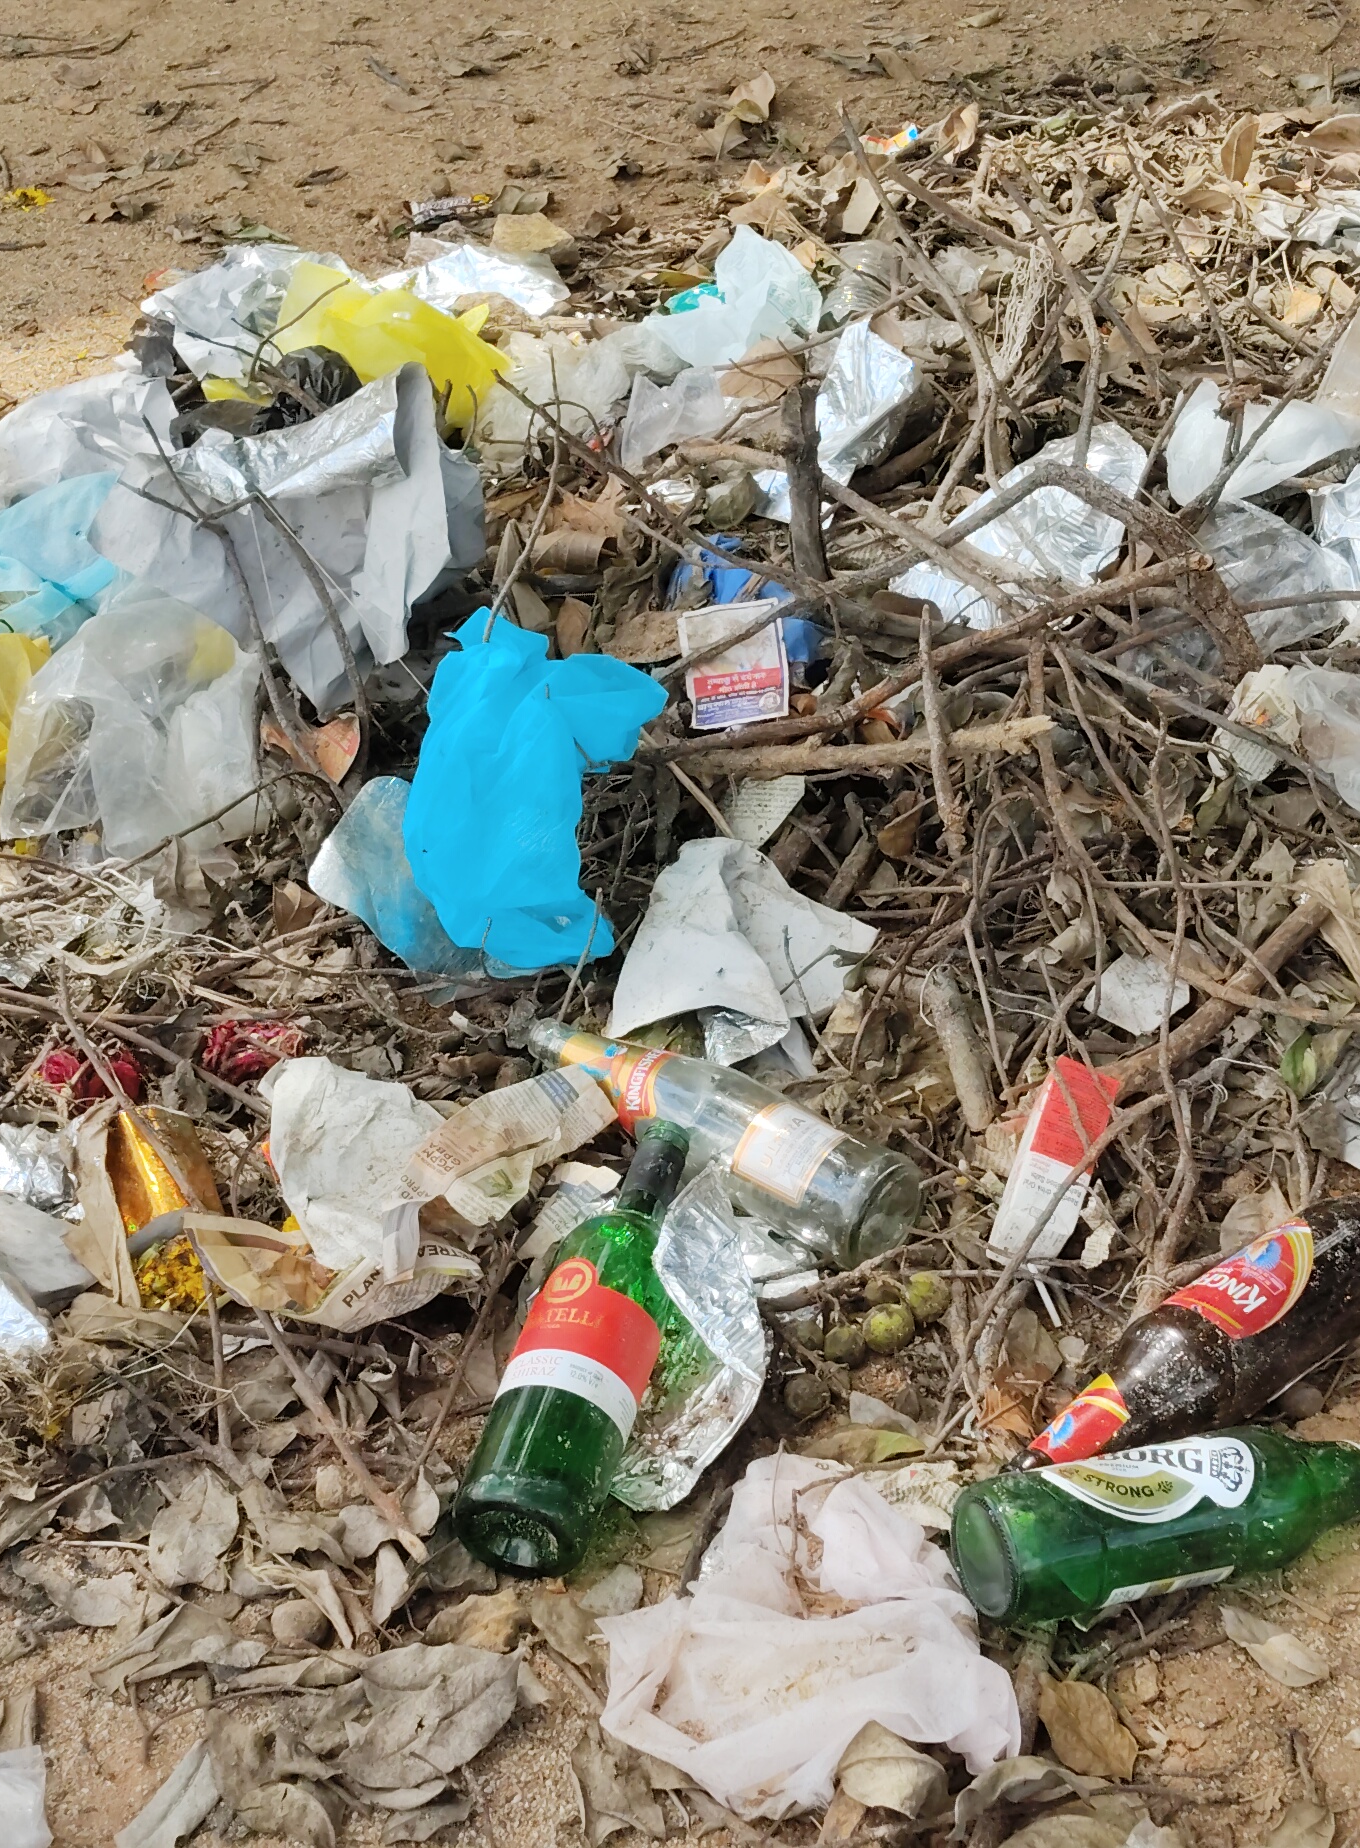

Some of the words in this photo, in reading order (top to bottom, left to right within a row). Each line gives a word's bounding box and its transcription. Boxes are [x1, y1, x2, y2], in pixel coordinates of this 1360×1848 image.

[515, 1355, 563, 1367] CLASSIC
[512, 1366, 556, 1380] SHIRAZ
[1082, 1474, 1155, 1498] STRONG
